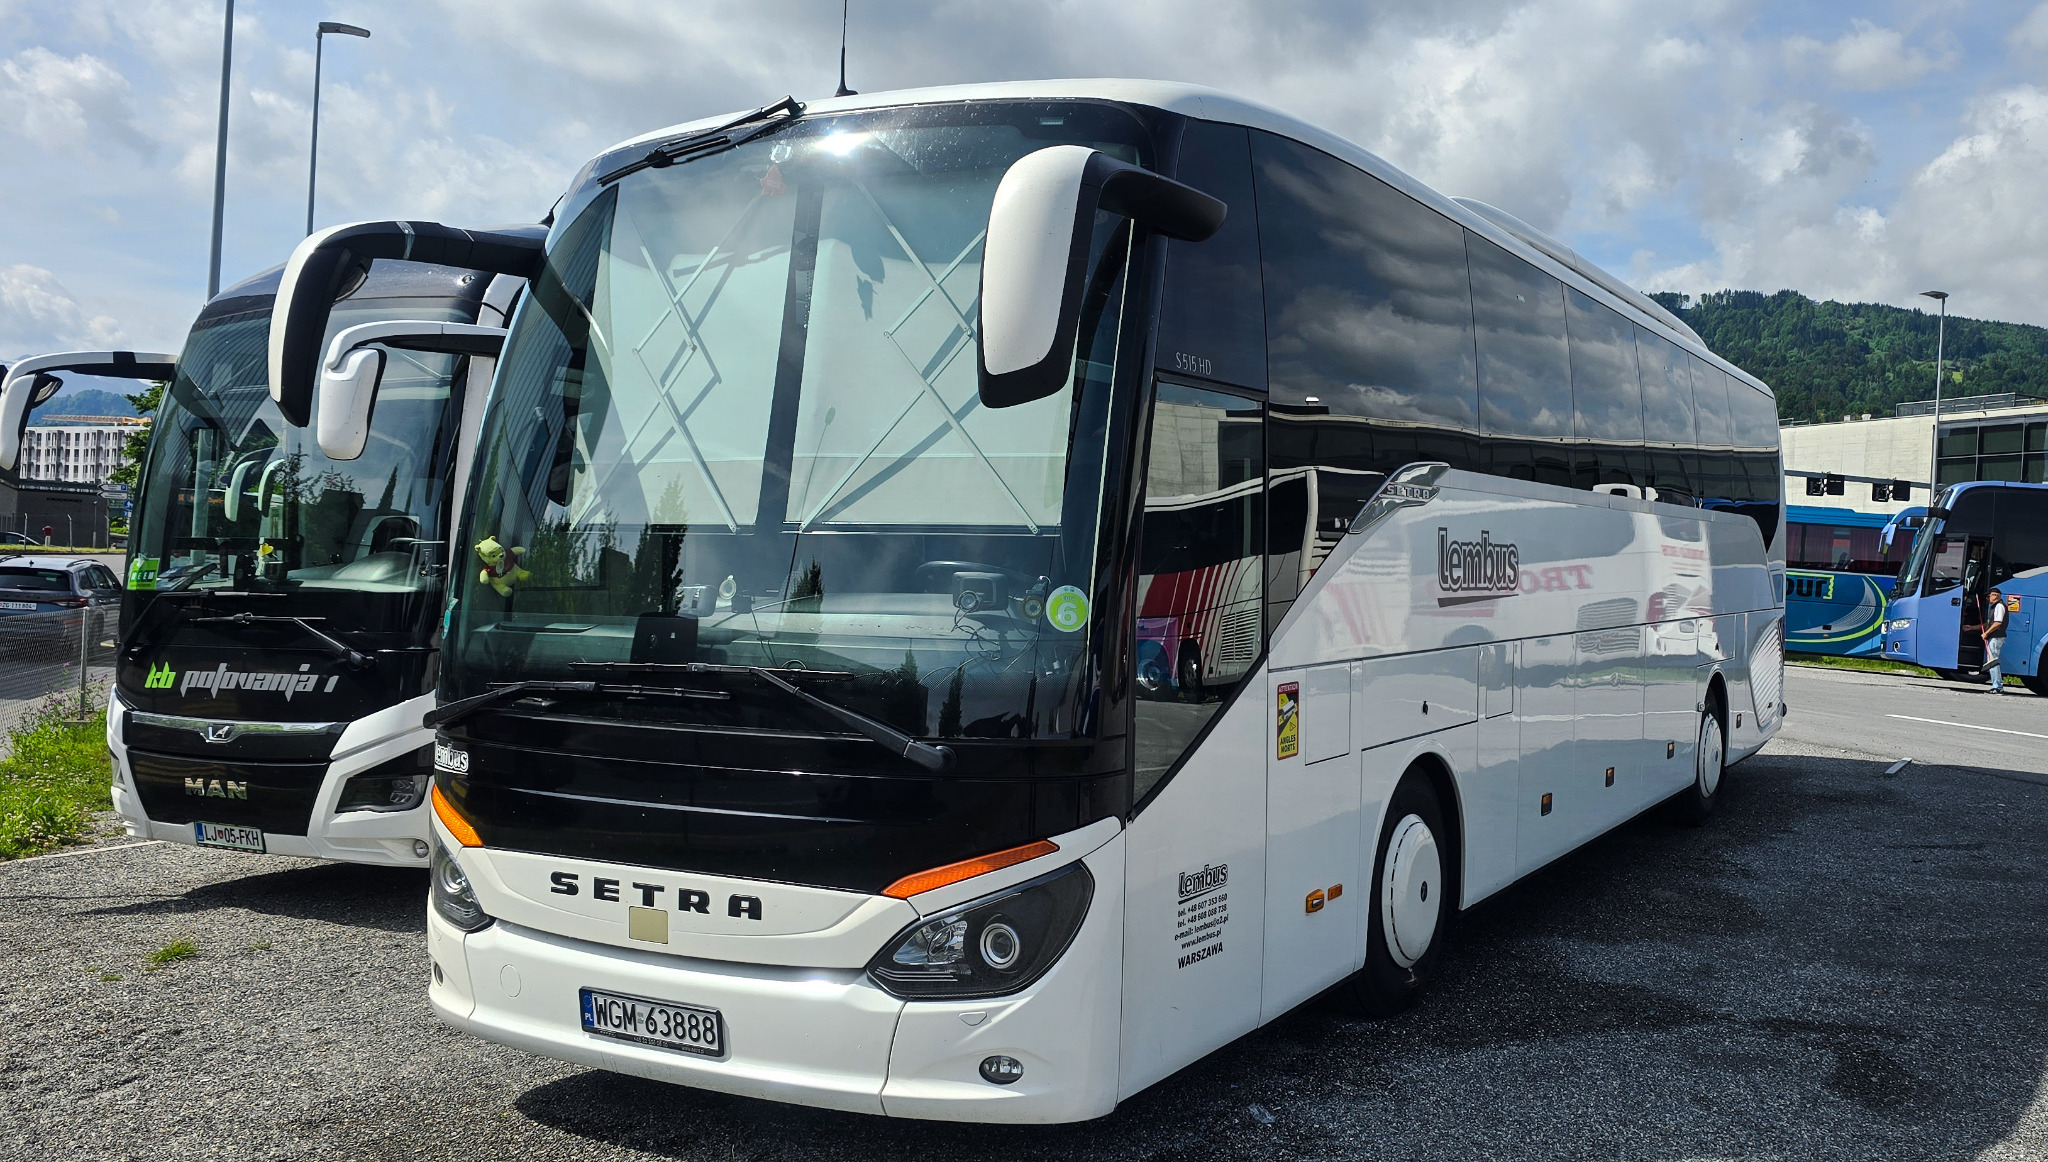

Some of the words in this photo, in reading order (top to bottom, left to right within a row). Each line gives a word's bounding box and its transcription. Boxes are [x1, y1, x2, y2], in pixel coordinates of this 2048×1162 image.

[1175, 351, 1182, 369] S
[1183, 353, 1197, 372] 515
[1198, 357, 1212, 376] HD
[1386, 484, 1431, 500] SETRA
[1438, 527, 1519, 592] lembus
[1057, 602, 1079, 626] 6
[144, 661, 177, 689] kb
[184, 777, 248, 800] MAN
[203, 825, 218, 842] LJ
[1178, 863, 1228, 898] lembus
[550, 871, 763, 921] SETRA
[1177, 941, 1224, 970] WARSZAWA
[584, 1012, 594, 1022] PL
[593, 996, 638, 1033] WGM
[644, 1006, 717, 1045] 63888
